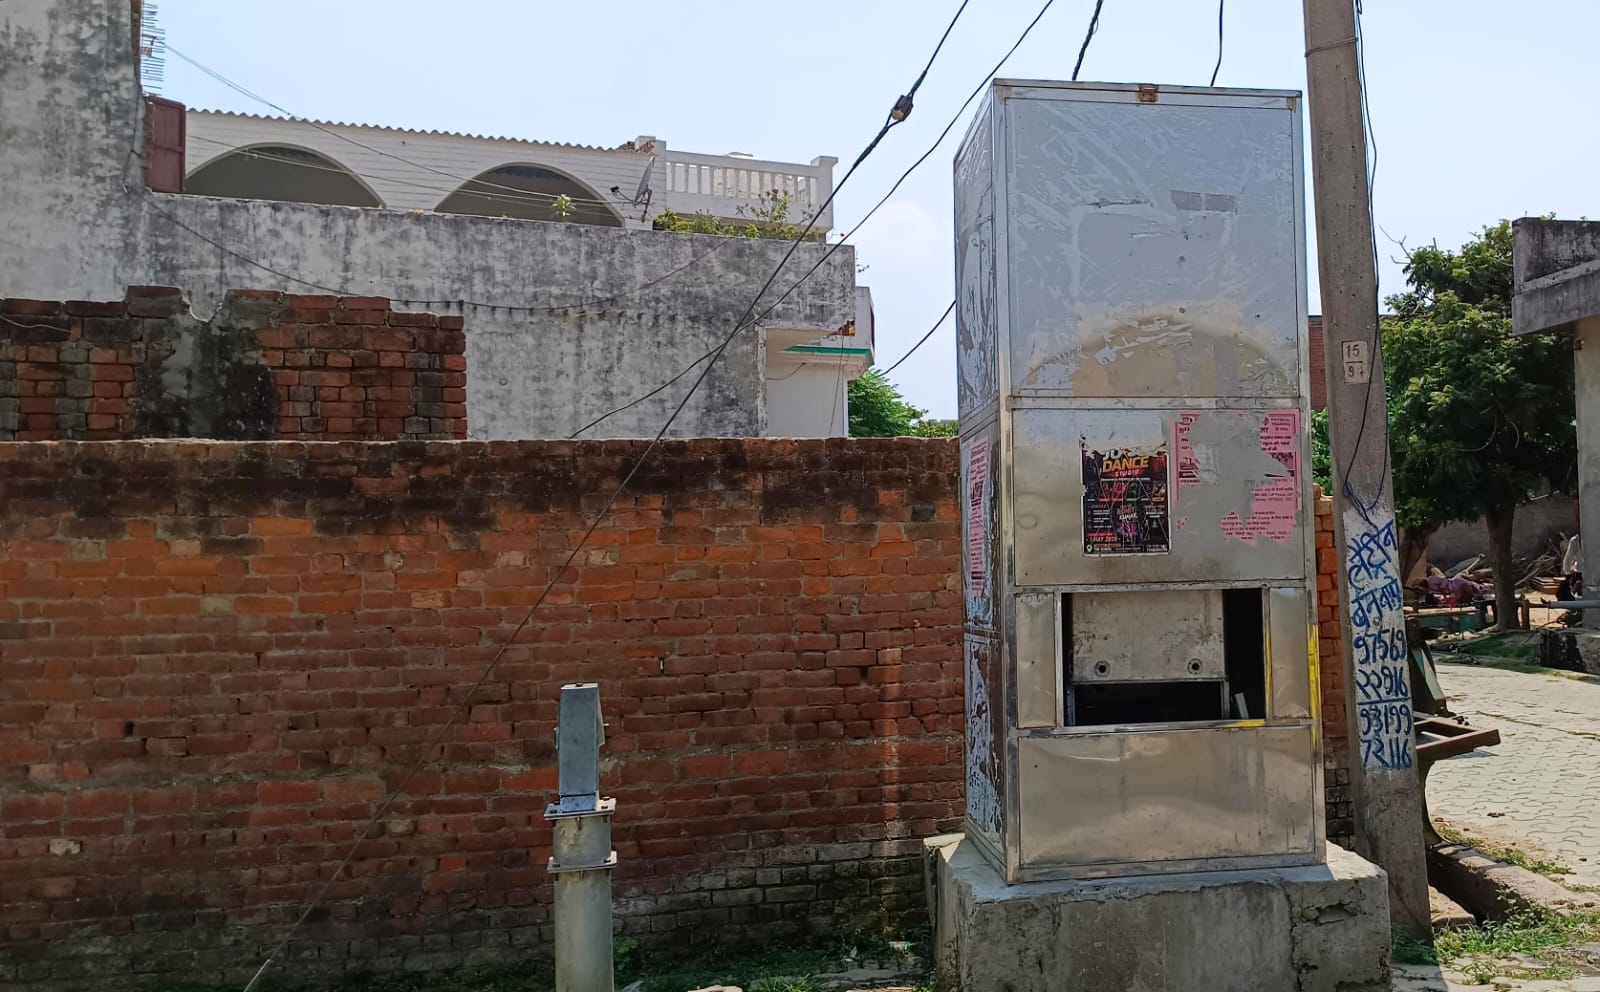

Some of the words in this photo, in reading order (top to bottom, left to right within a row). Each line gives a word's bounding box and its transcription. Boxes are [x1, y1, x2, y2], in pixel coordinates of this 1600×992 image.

[1346, 344, 1360, 358] 15
[1103, 456, 1149, 472] DANCE
[1353, 627, 1407, 665] 97569
